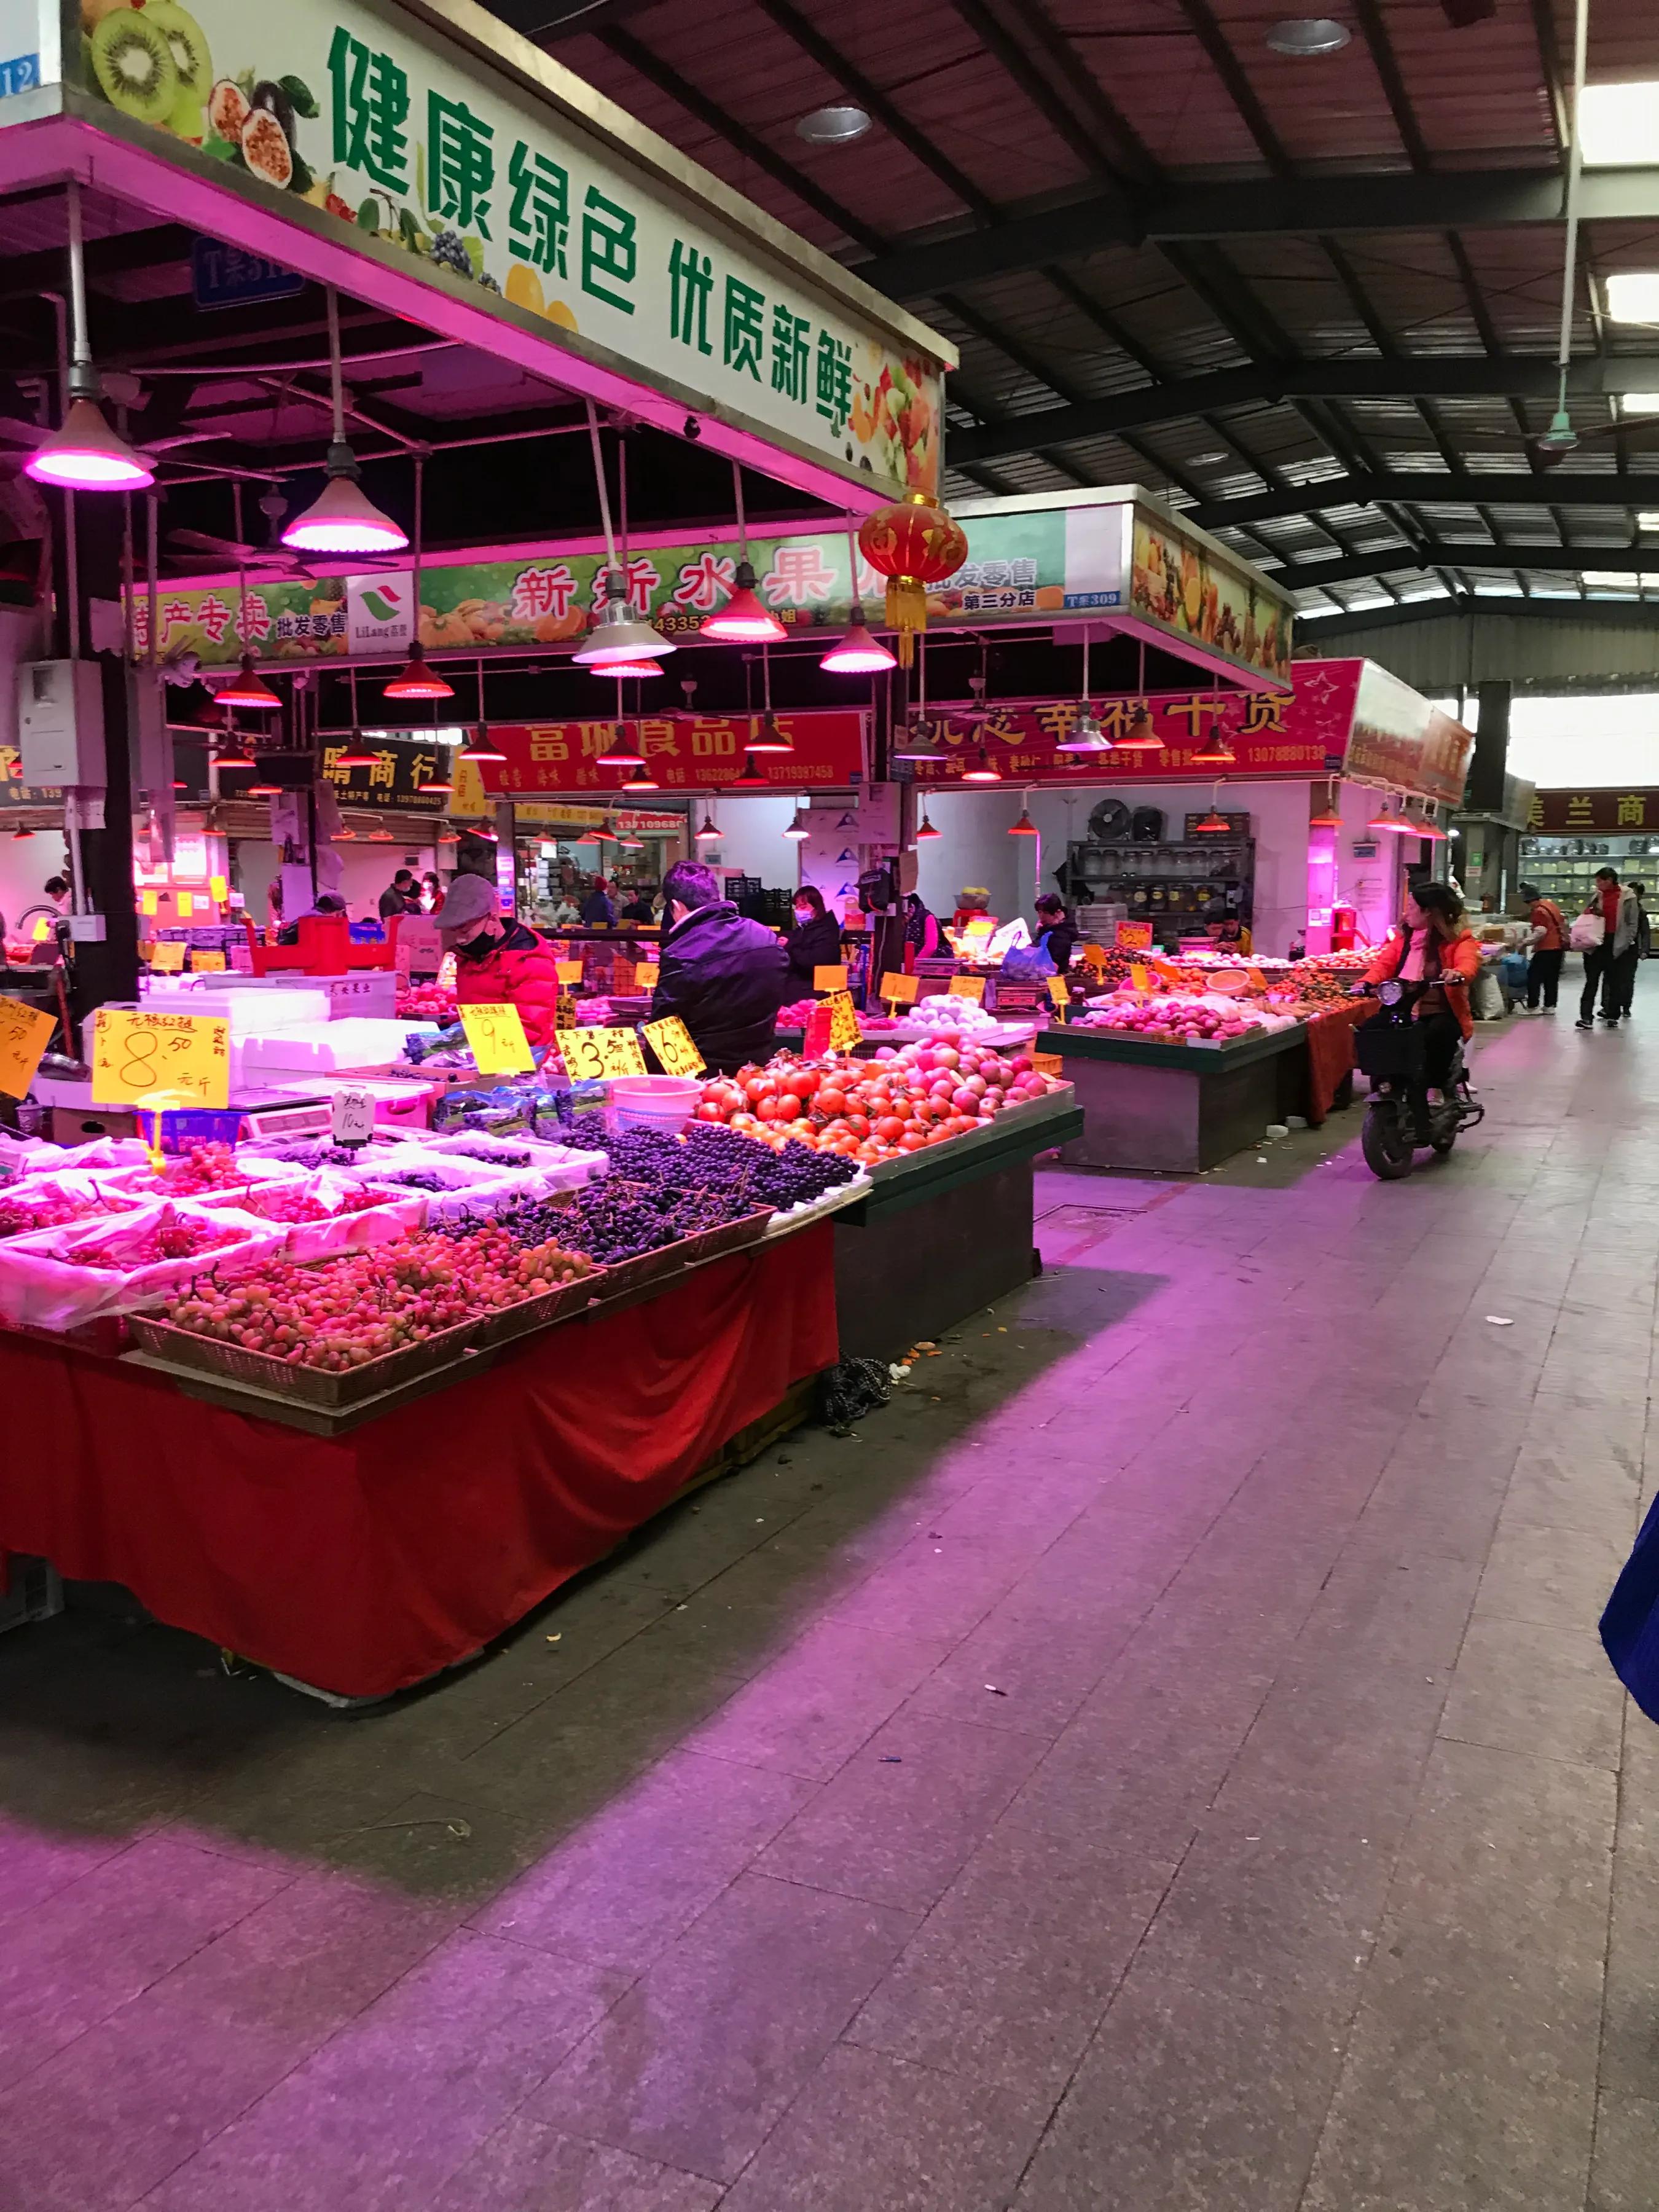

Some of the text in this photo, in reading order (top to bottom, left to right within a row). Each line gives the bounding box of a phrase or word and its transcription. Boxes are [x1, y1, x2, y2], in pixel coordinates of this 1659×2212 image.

[328, 26, 853, 437] 健康绿色 优质新鲜
[512, 547, 889, 619] 新新水果
[963, 592, 1035, 610] 第三分店
[277, 612, 346, 637] 批发零售
[481, 1018, 495, 1054] 9
